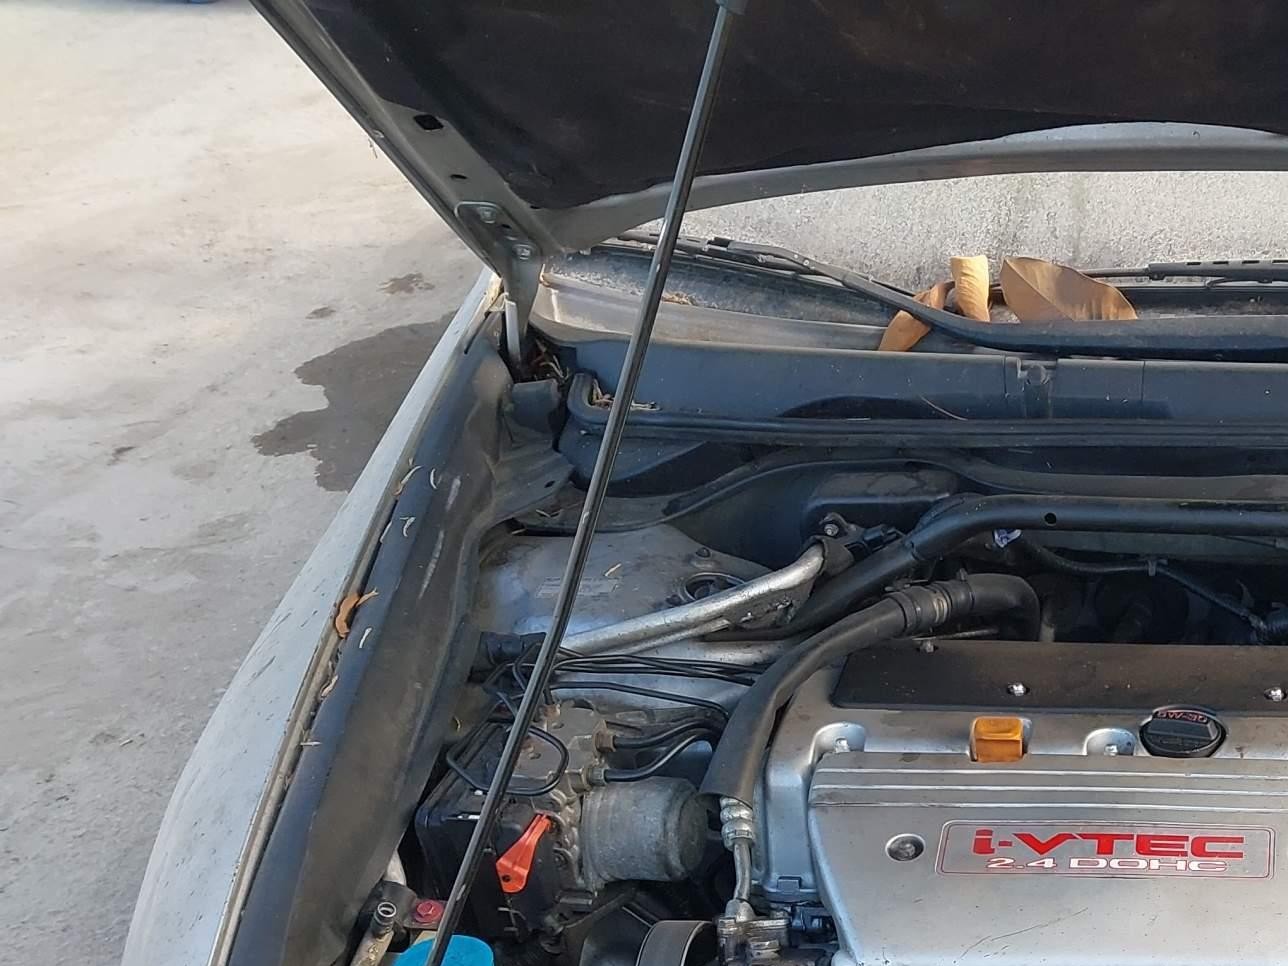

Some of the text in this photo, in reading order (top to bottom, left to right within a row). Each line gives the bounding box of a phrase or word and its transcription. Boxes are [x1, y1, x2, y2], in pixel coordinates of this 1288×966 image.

[972, 828, 1245, 859] i-VTEC
[986, 857, 1228, 872] 2.4 DOHC
